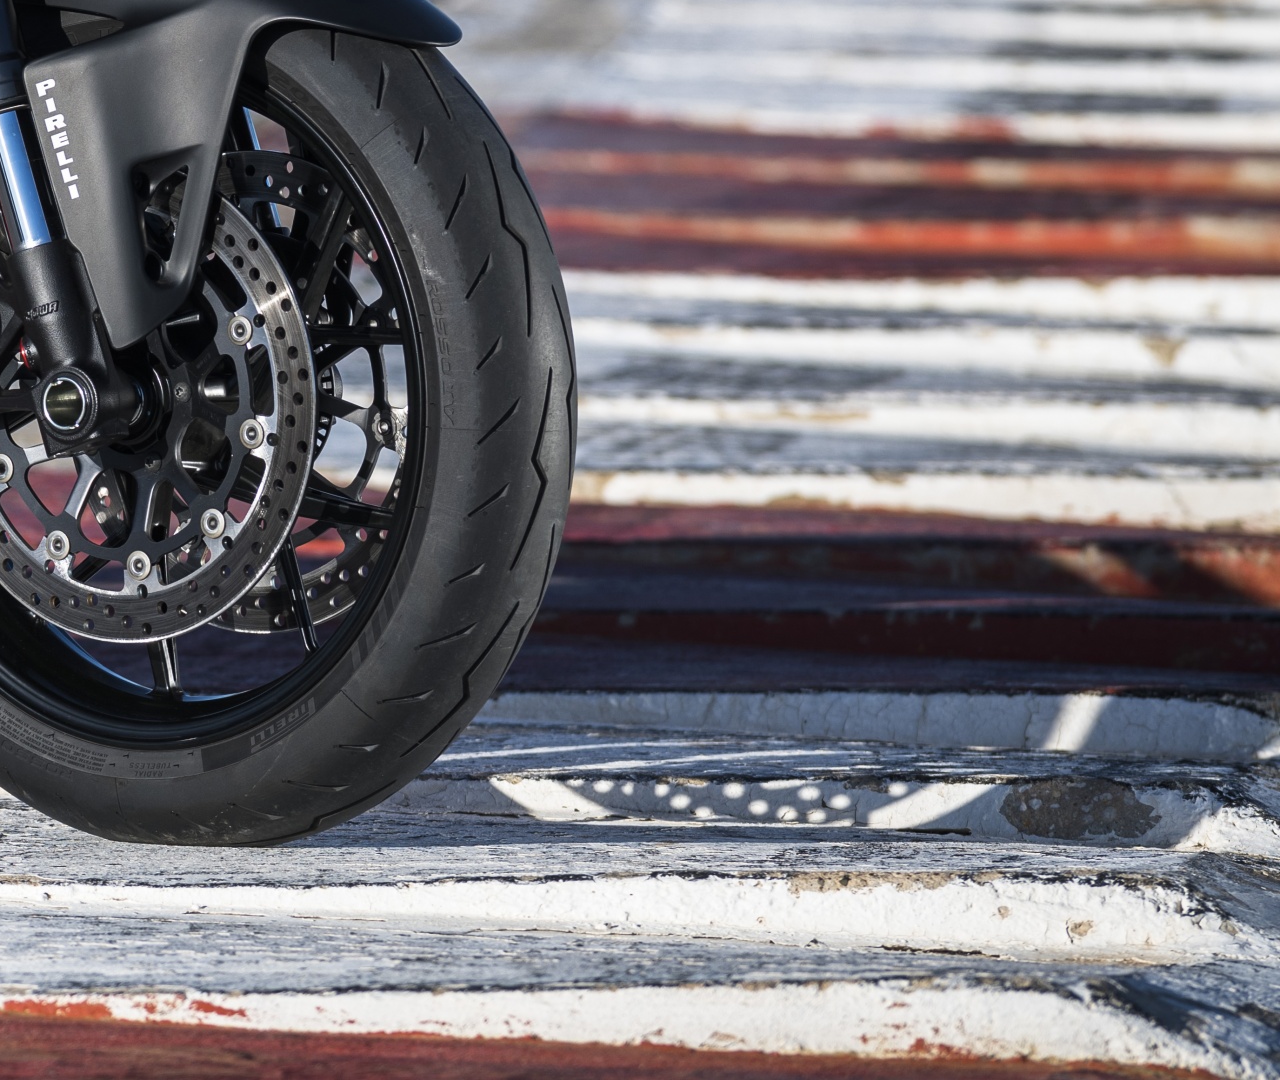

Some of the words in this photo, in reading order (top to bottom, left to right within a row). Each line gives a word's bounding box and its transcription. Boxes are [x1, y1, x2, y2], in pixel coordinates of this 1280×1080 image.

[34, 77, 80, 200] PIRELLI
[249, 695, 317, 755] PIRELLI
[127, 760, 172, 771] TUBELESS
[134, 768, 164, 779] RADIAL
